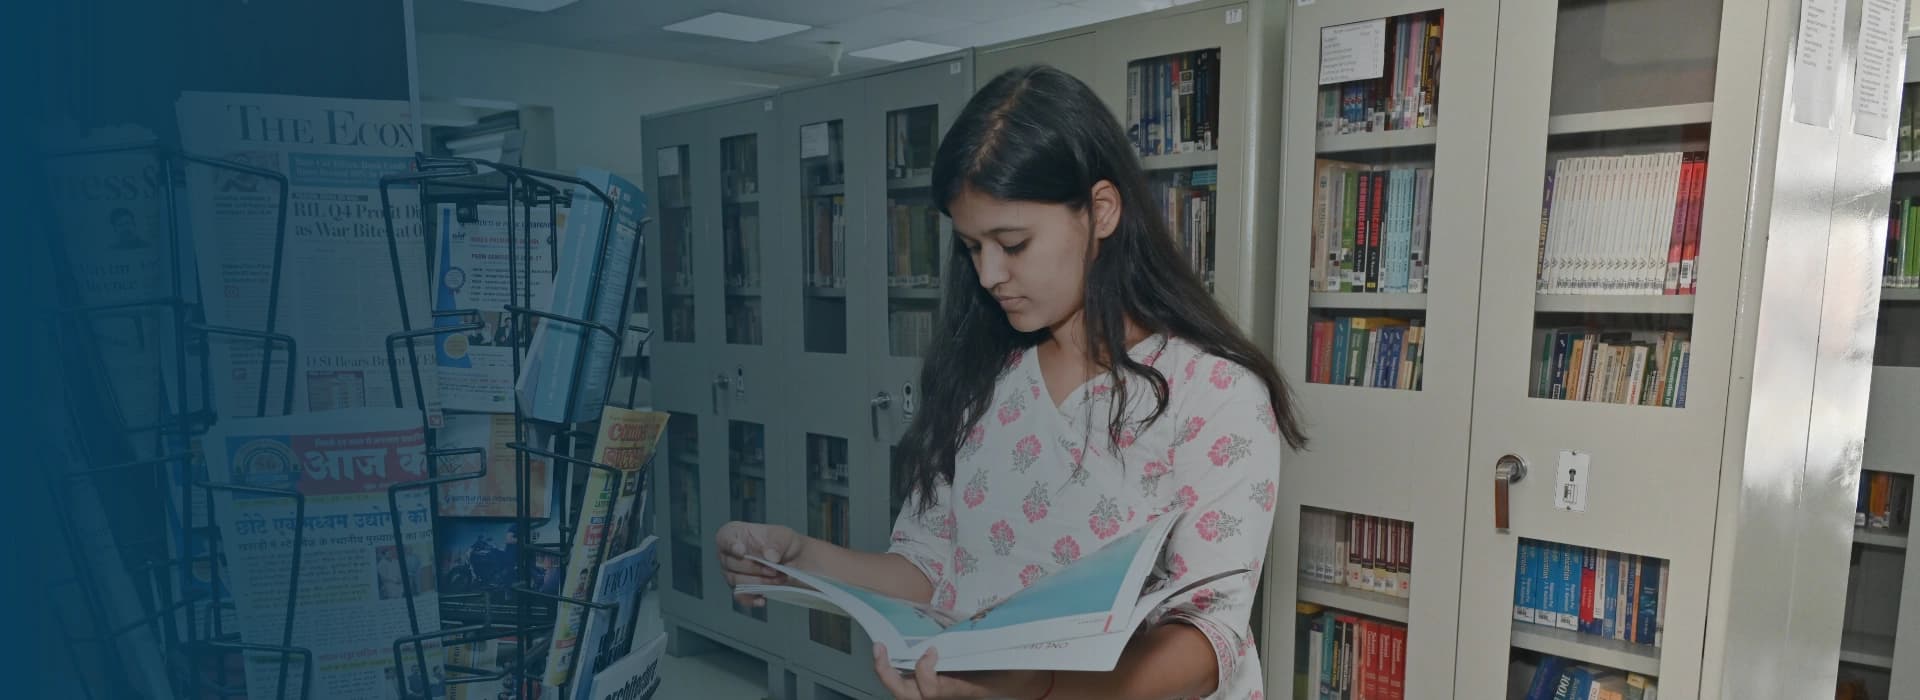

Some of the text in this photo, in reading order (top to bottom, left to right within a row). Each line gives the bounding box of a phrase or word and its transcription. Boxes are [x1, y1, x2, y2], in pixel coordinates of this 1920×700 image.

[356, 204, 401, 220] Proit
[353, 223, 393, 238] Bite
[303, 447, 388, 481] आज
